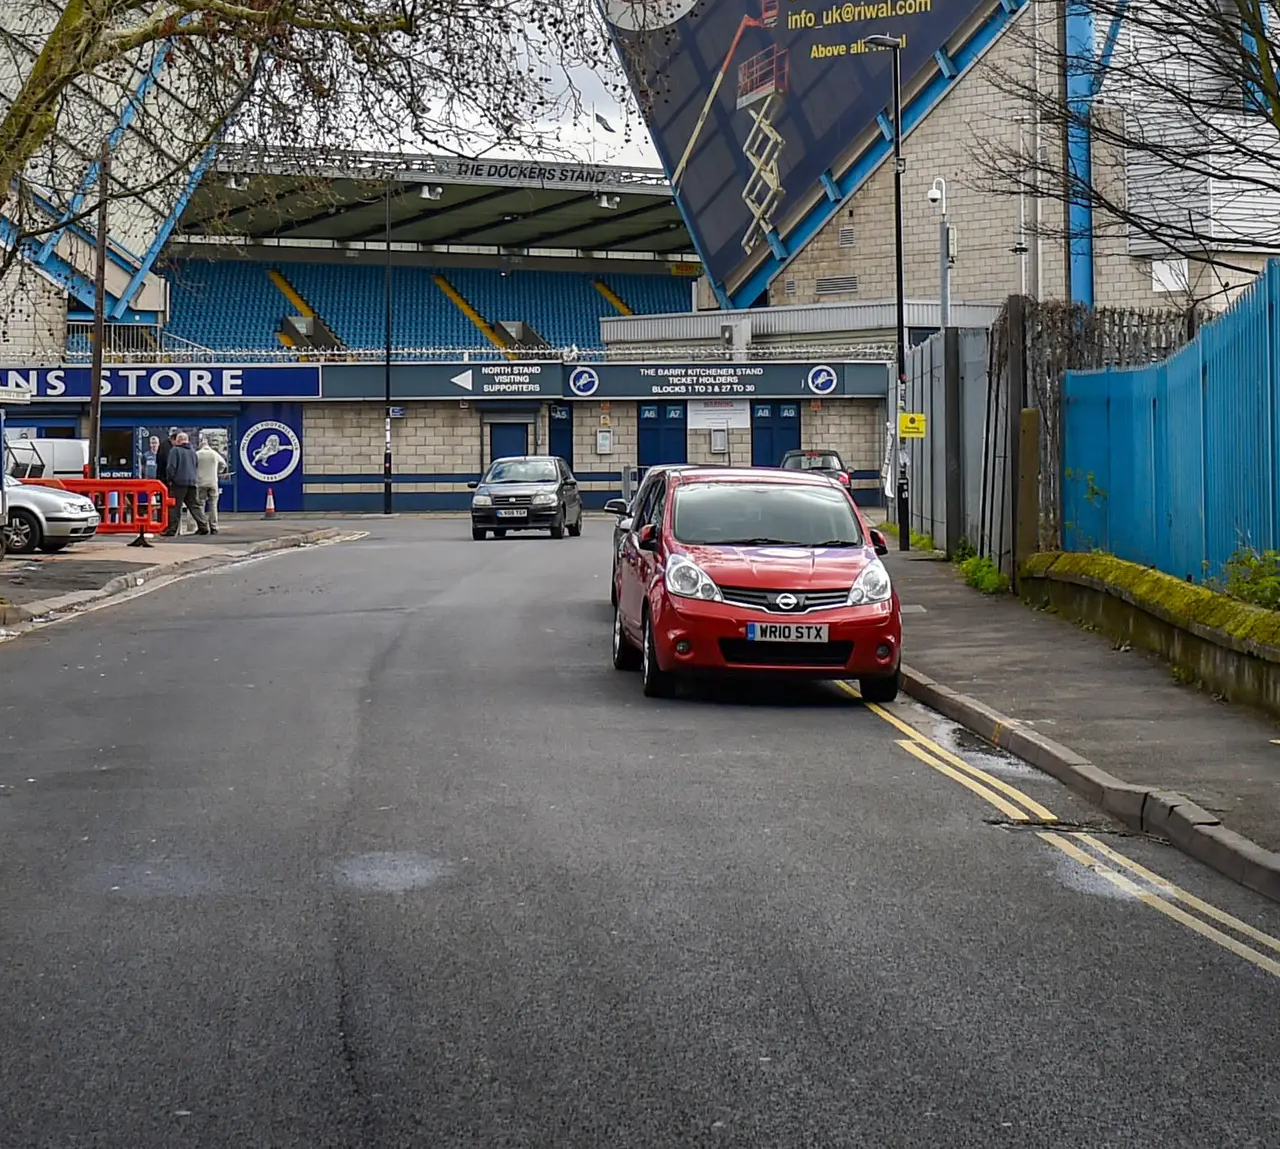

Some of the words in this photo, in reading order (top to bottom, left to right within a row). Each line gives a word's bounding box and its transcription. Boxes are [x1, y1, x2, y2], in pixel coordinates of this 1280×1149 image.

[810, 44, 846, 59] Above
[456, 163, 483, 177] THE
[487, 164, 556, 181] DOCKERS
[559, 169, 607, 183] STAND
[482, 366, 512, 374] NORTH
[513, 366, 541, 374] STAND
[100, 370, 243, 395] STORE
[494, 375, 529, 383] VISITING
[668, 376, 697, 384] TICKET
[483, 384, 540, 392] SUPPORTERS
[643, 410, 655, 418] A6
[669, 410, 680, 418] A7
[757, 409, 769, 417] A8
[783, 409, 795, 417] A9
[759, 625, 791, 639] WR10
[795, 625, 822, 639] STX
